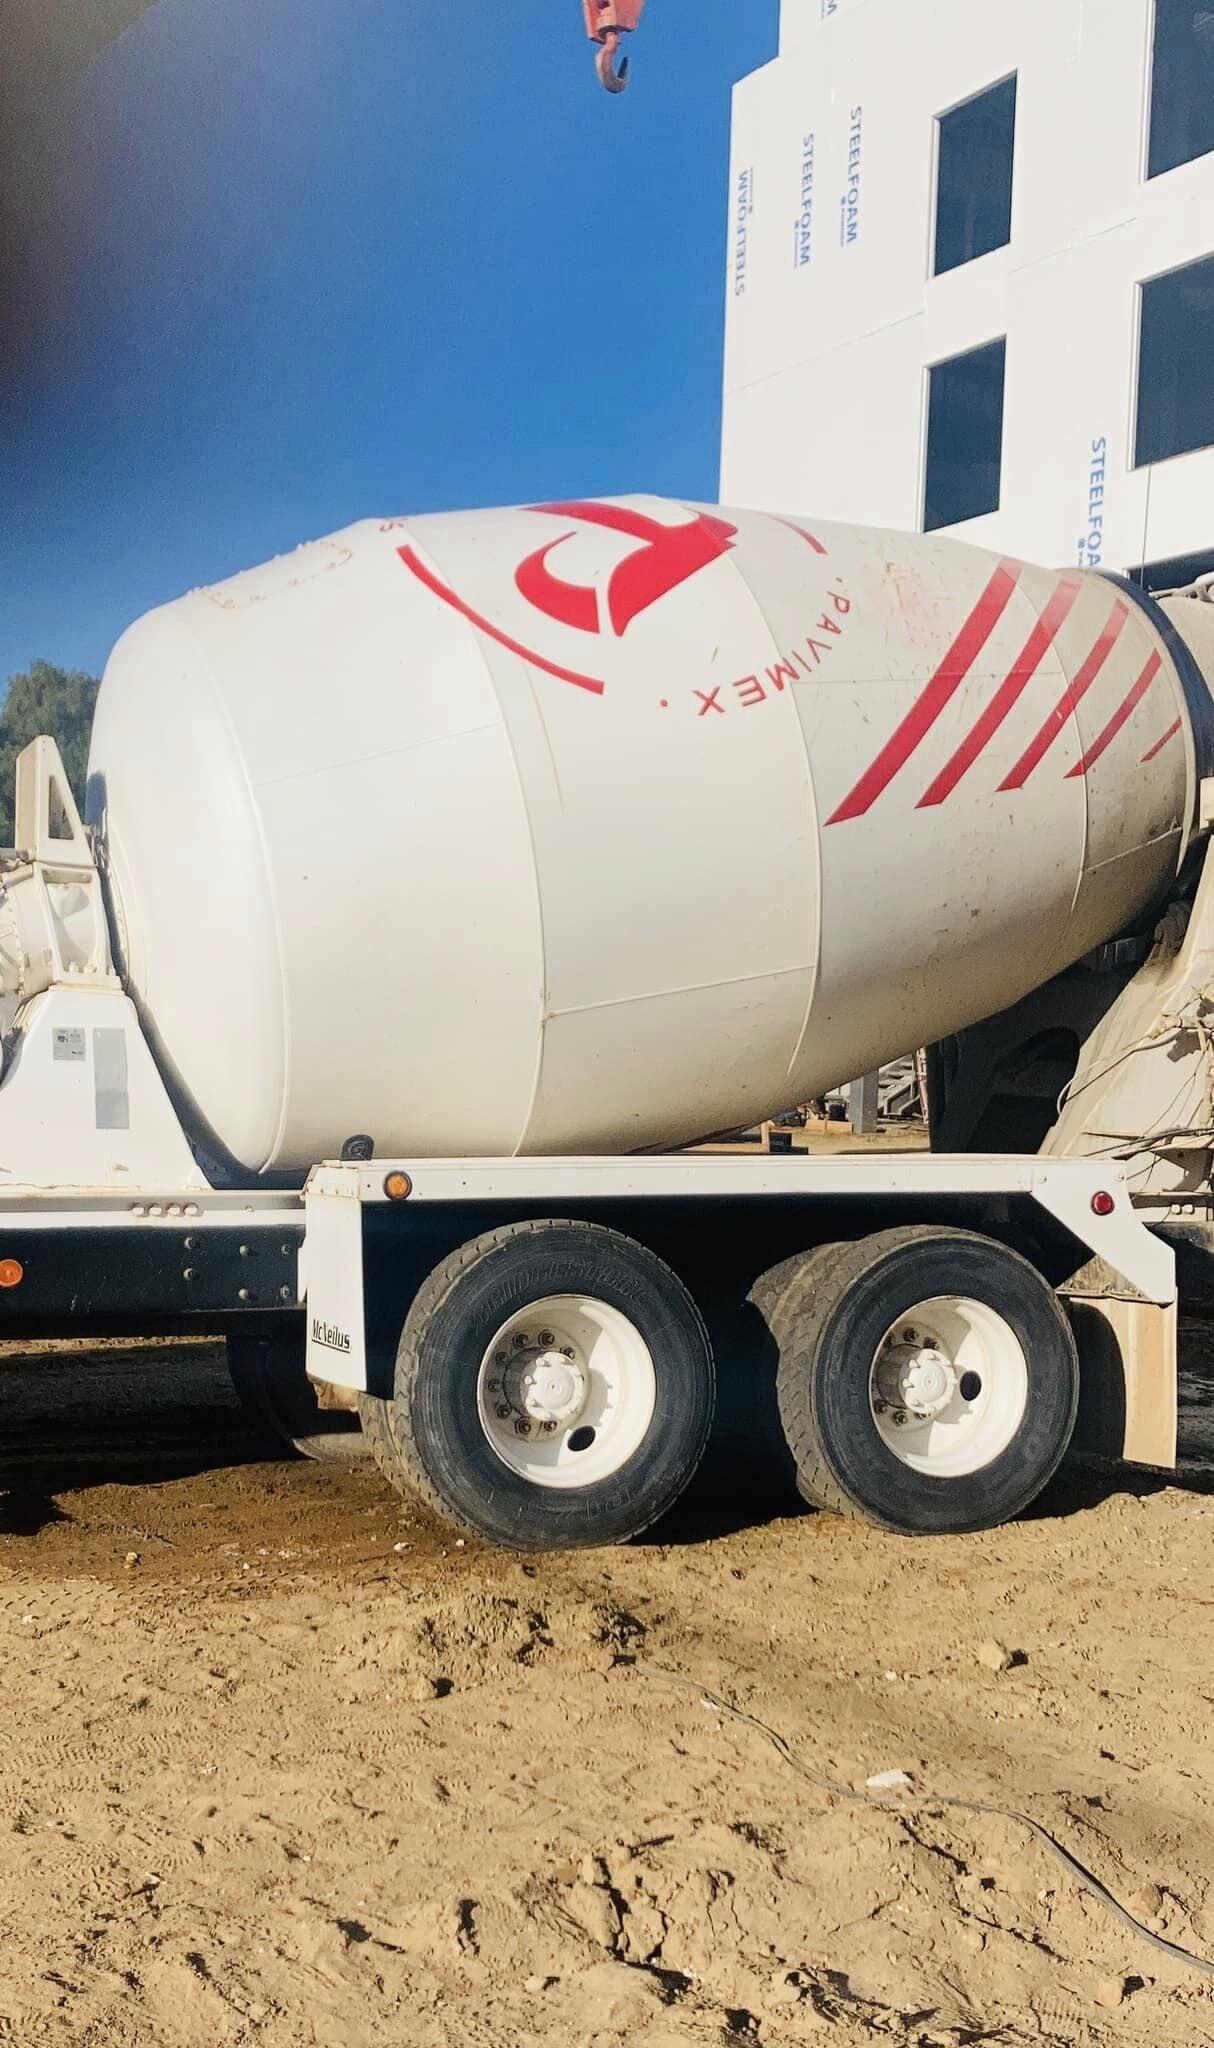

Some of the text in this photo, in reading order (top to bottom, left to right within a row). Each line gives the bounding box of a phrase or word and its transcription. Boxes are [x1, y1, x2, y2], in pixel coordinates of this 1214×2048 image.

[735, 170, 748, 296] STEELFOAM
[799, 132, 814, 265] STEELFOAM
[847, 105, 862, 243] STEELFOAM
[1088, 436, 1107, 567] STEELFOA
[693, 589, 852, 716] PAVIMEX
[311, 1319, 351, 1350] McNeilus
